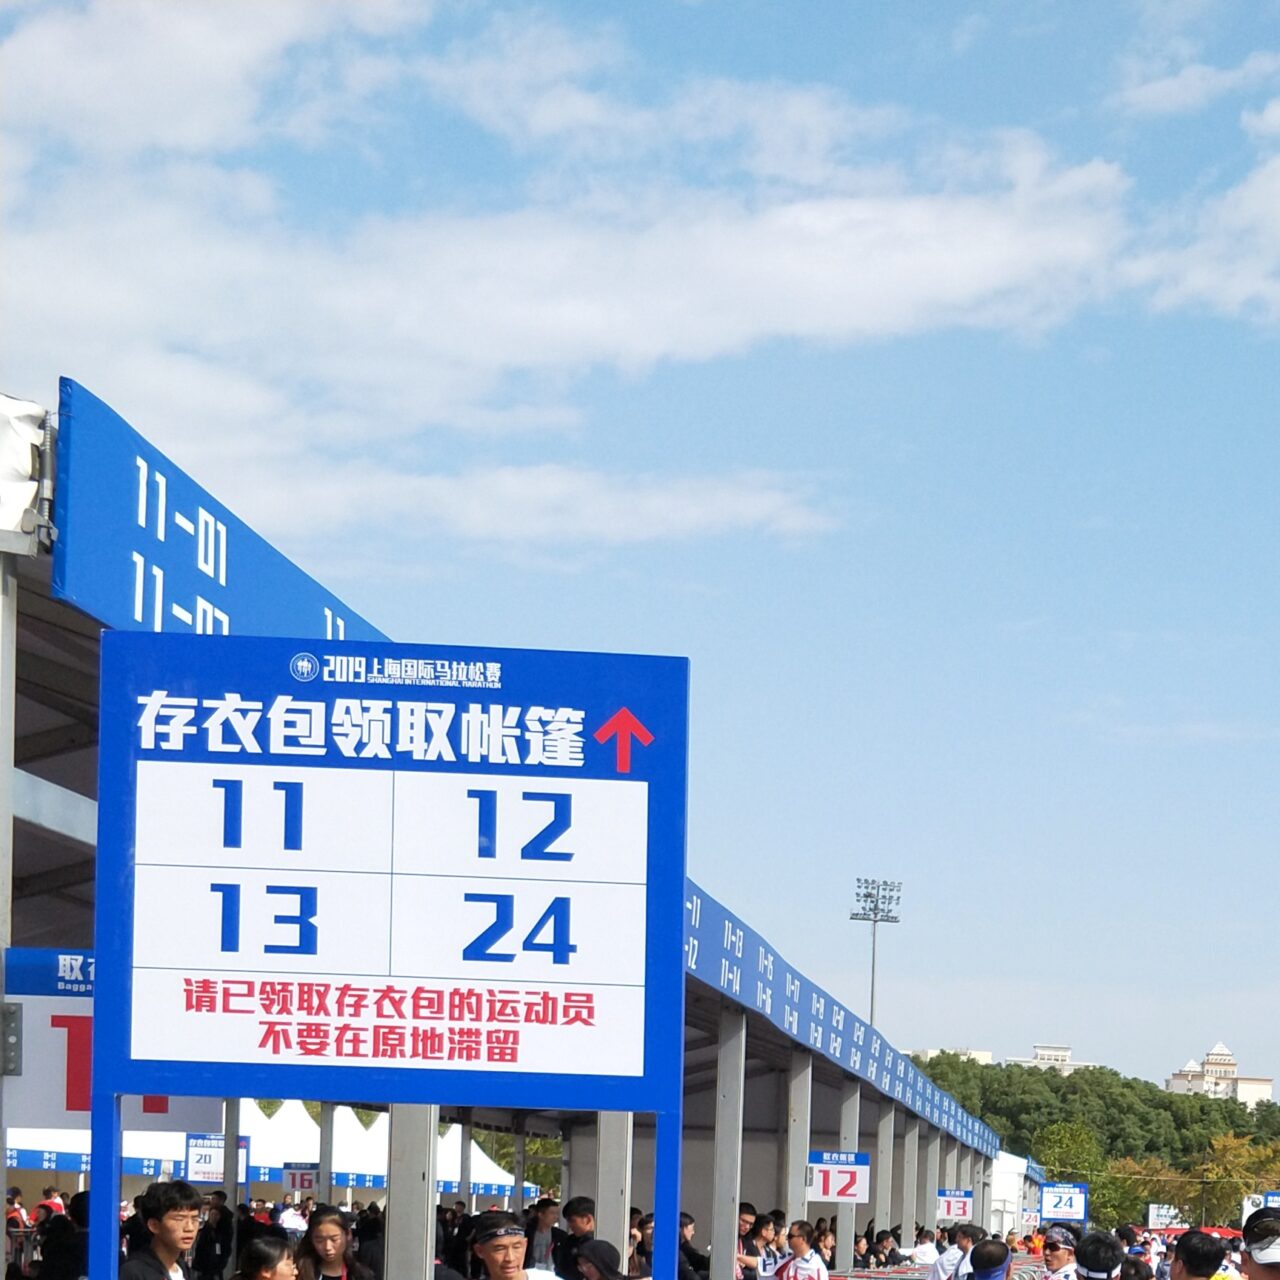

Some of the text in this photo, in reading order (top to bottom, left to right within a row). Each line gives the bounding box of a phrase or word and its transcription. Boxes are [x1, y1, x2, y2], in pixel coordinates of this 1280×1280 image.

[135, 455, 229, 587] 11-01
[323, 655, 366, 683] 2019
[367, 657, 502, 683] 上海国际马拉松赛
[367, 676, 502, 689] SHANGHAI INTERNATIONAL MARATHON
[137, 690, 586, 769] 存衣包领取帐篷
[212, 779, 303, 851] 11
[467, 789, 575, 862] 12
[210, 883, 318, 955] 13
[462, 893, 578, 965] 24
[723, 920, 743, 958] 11-13
[720, 958, 741, 996] 11-14
[184, 977, 597, 1028] 请已领取存衣包的运动员
[257, 1021, 520, 1064] 不要在原地滞留
[289, 1172, 313, 1189] 16
[818, 1169, 858, 1198] 12
[943, 1200, 967, 1217] 13
[1053, 1195, 1073, 1209] 24
